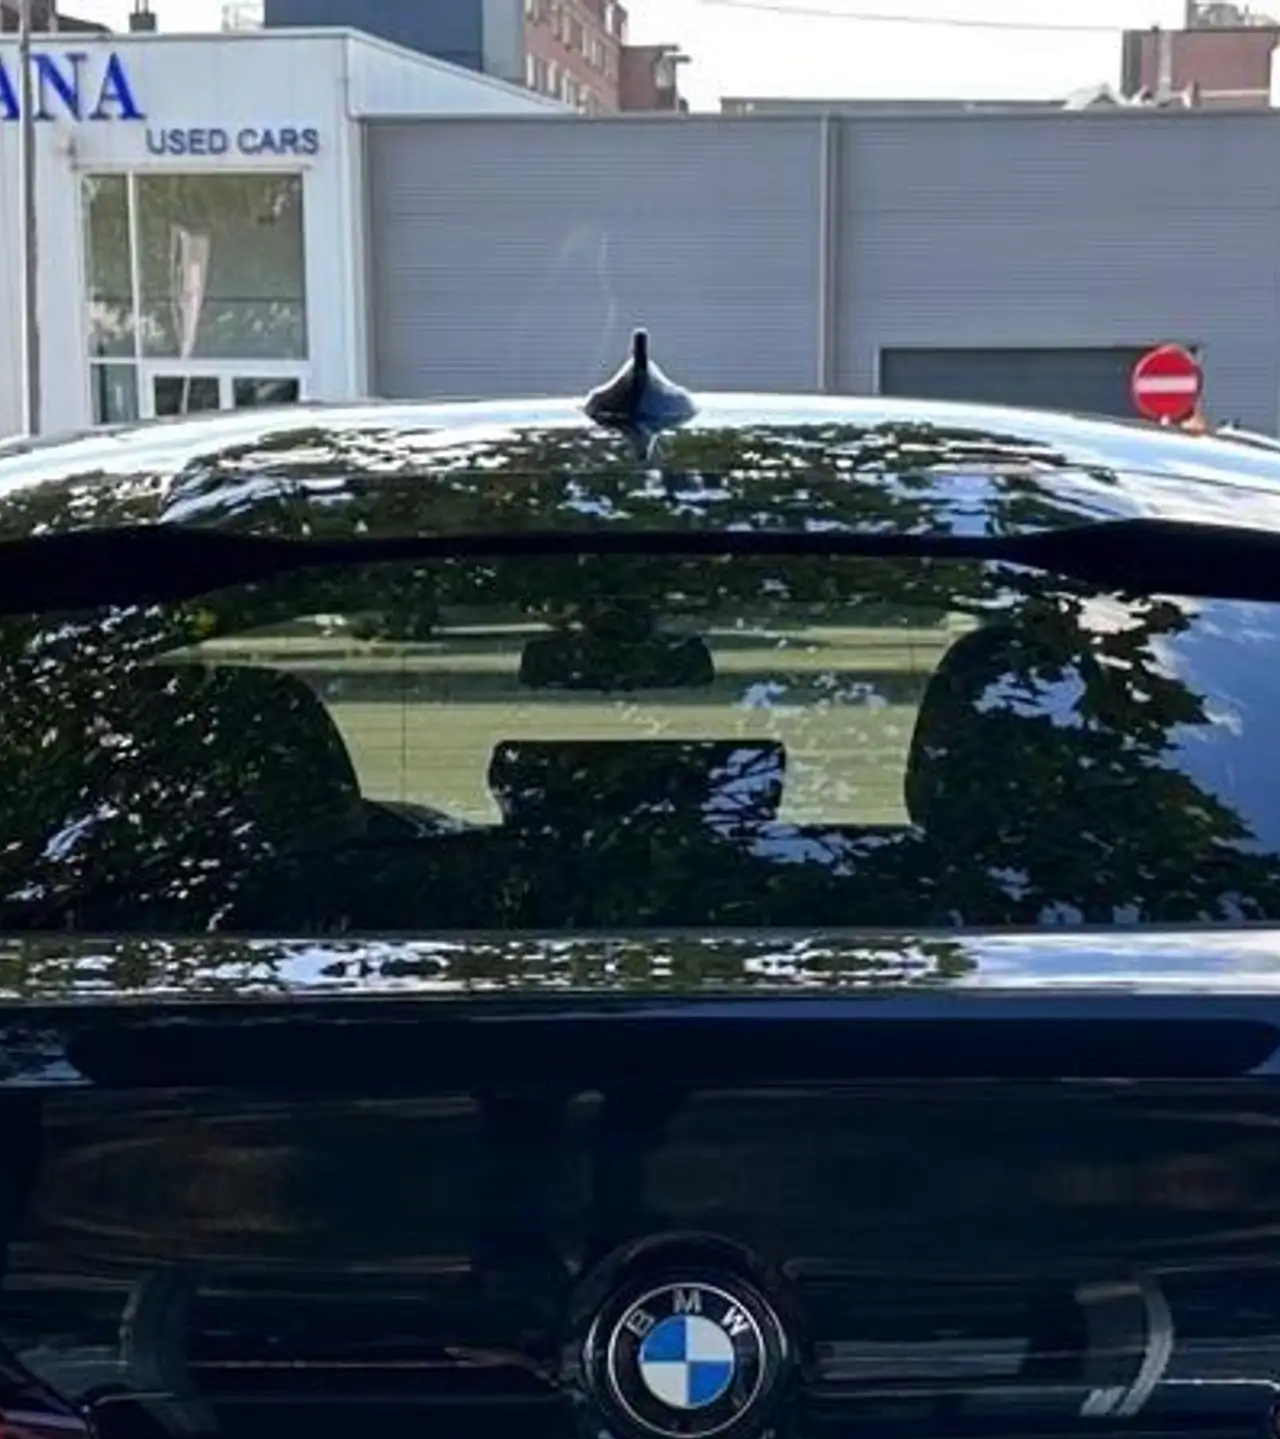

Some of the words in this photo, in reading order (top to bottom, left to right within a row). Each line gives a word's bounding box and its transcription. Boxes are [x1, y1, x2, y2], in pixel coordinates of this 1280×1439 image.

[145, 129, 230, 155] USED
[237, 129, 320, 155] CARS
[625, 1288, 751, 1338] BMW
